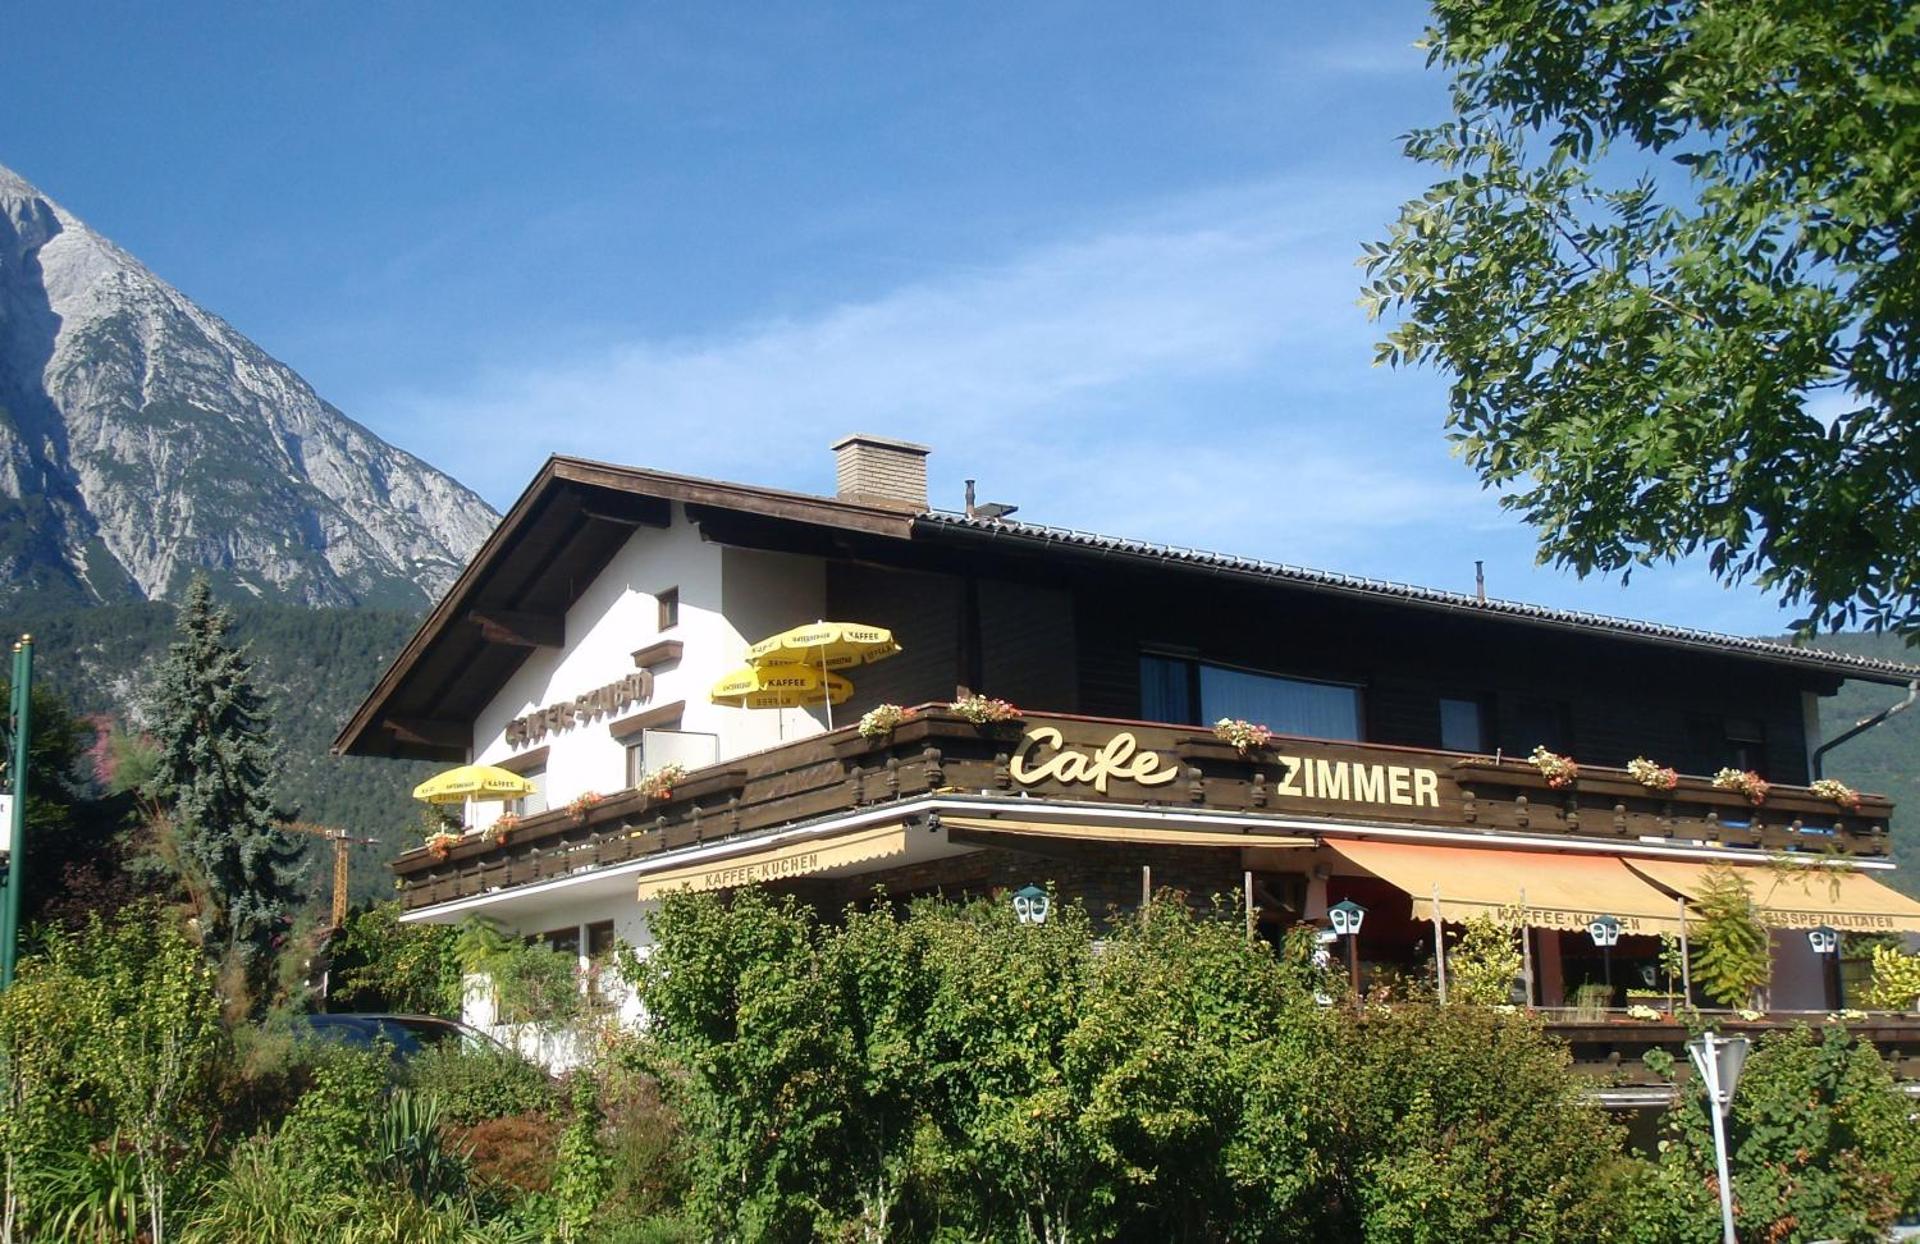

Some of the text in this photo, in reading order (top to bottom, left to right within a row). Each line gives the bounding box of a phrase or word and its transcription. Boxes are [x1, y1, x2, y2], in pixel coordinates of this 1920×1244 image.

[849, 631, 879, 640] KAFFEE
[768, 678, 806, 687] KAFFEE
[1278, 755, 1439, 807] ZIMMER
[705, 867, 756, 887] KAFFEE
